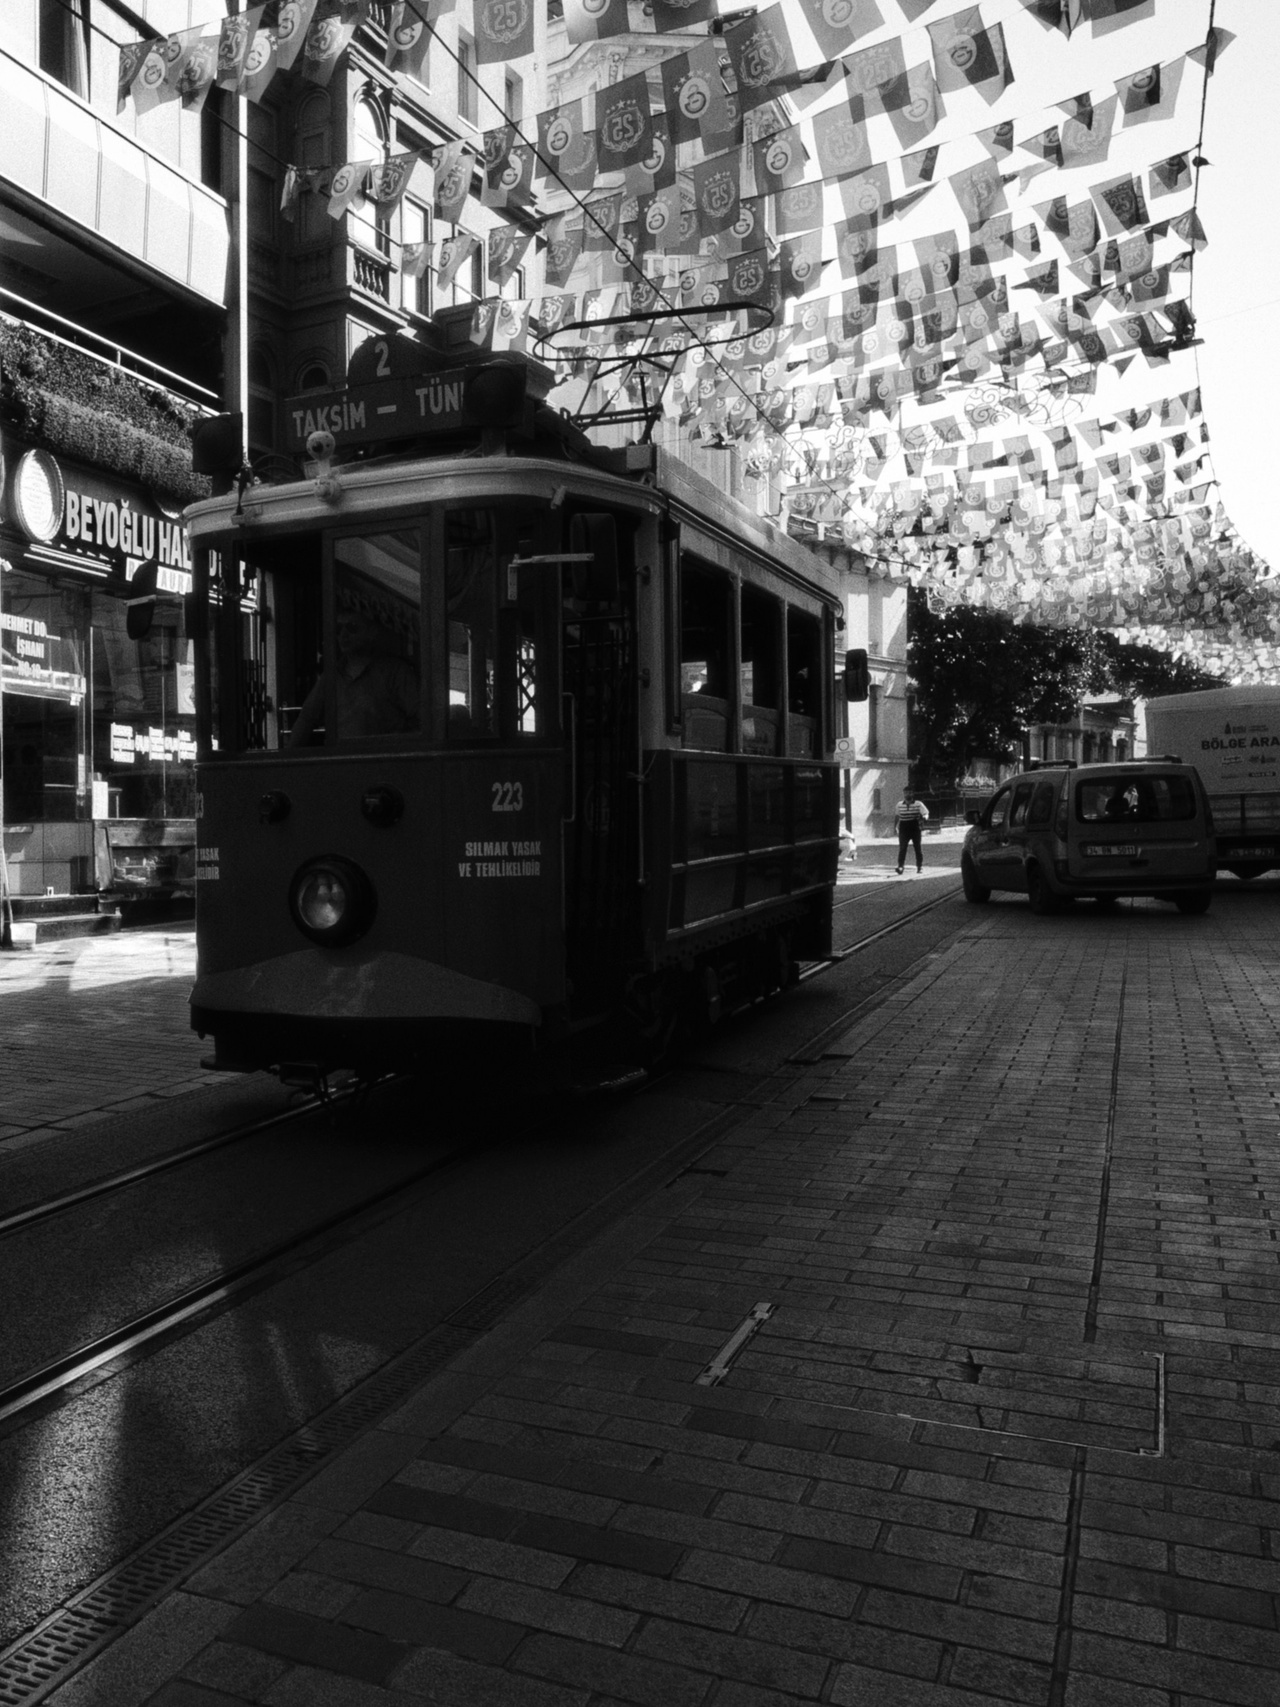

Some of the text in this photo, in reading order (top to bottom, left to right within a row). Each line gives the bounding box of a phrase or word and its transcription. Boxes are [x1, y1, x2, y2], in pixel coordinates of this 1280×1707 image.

[493, 2, 519, 30] 25
[374, 340, 391, 377] 2
[292, 395, 367, 438] TAKSİM
[415, 376, 465, 417] TÜN
[65, 489, 155, 561] BEYOĞLU
[1201, 737, 1247, 751] BÖLGE
[491, 781, 524, 812] 223
[465, 840, 542, 857] SILMAK YASAK
[458, 862, 472, 878] VE
